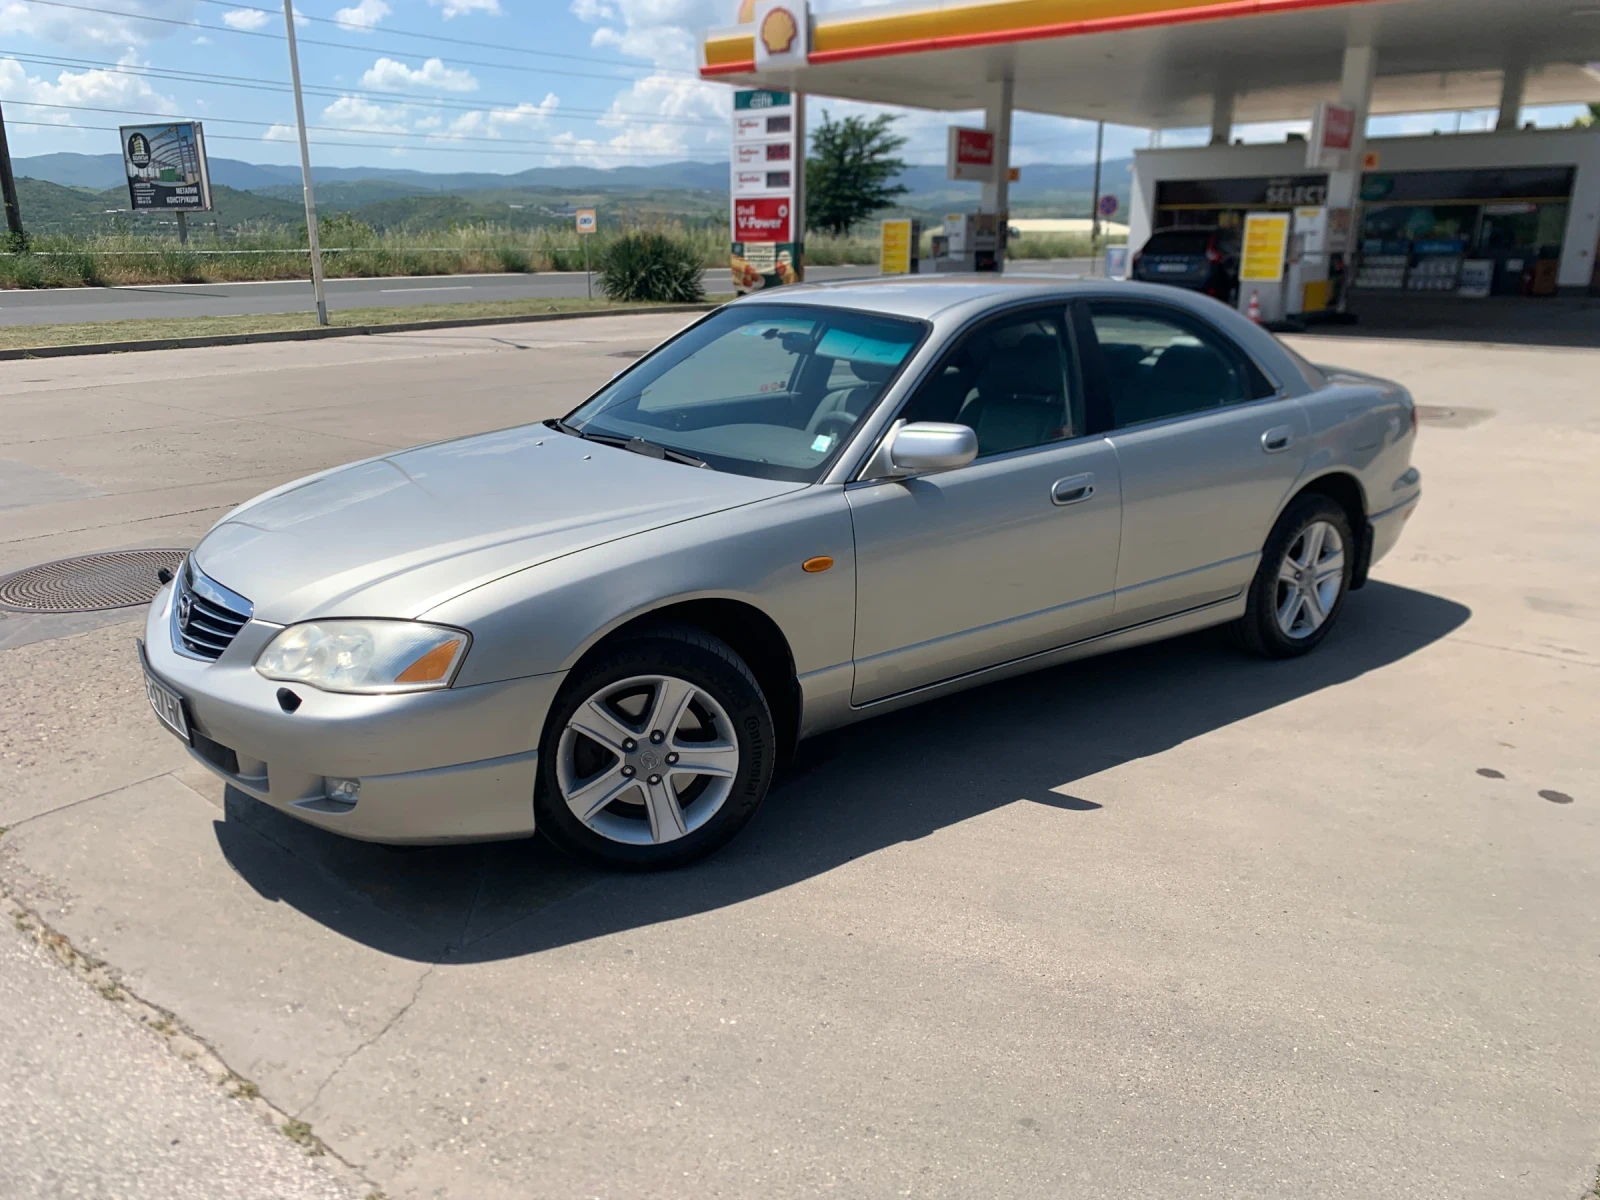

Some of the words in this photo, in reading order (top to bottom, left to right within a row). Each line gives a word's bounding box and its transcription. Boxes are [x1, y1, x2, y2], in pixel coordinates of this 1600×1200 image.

[166, 196, 199, 205] КОНСТРУКЦИИ
[1266, 186, 1326, 203] SELECT
[737, 204, 755, 215] Shell
[737, 217, 782, 229] V-Power
[744, 715, 765, 797] Continental
